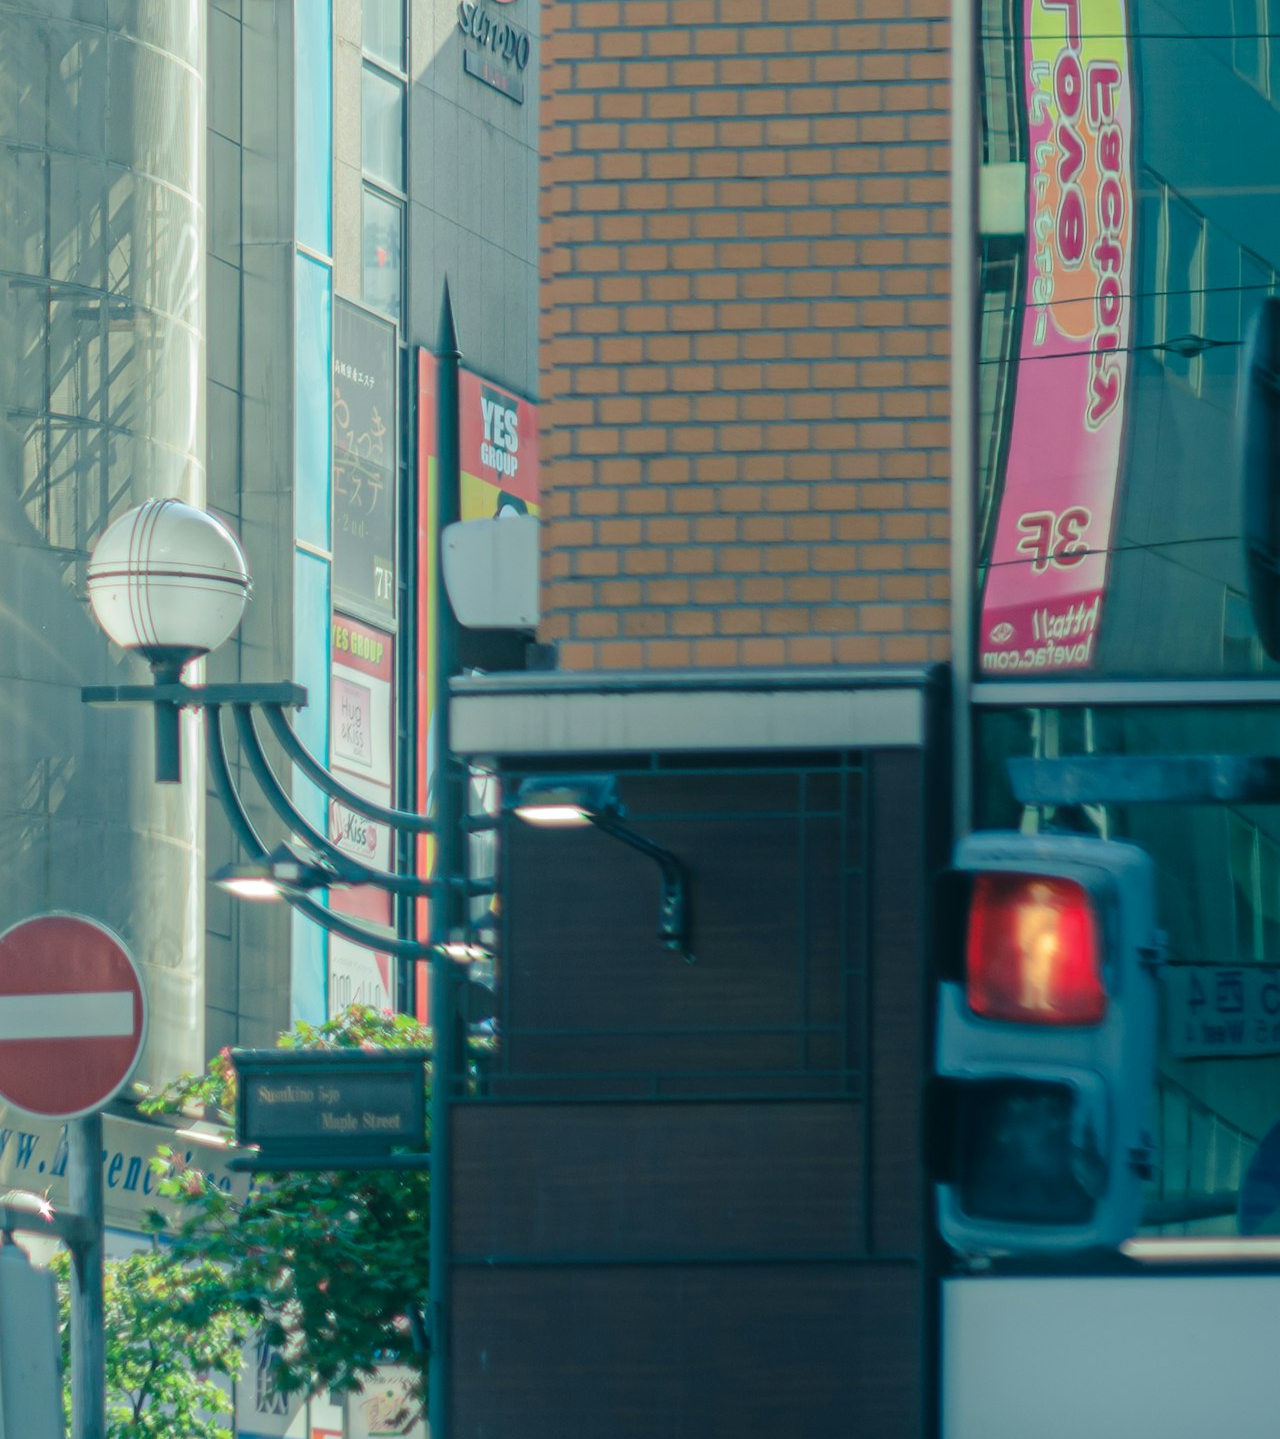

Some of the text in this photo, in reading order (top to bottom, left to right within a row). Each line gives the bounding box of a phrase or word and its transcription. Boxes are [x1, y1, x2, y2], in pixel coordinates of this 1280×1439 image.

[480, 396, 520, 454] YES
[480, 441, 520, 478] GROUP
[350, 631, 383, 665] GROUP
[321, 1111, 401, 1132] Maple Street
